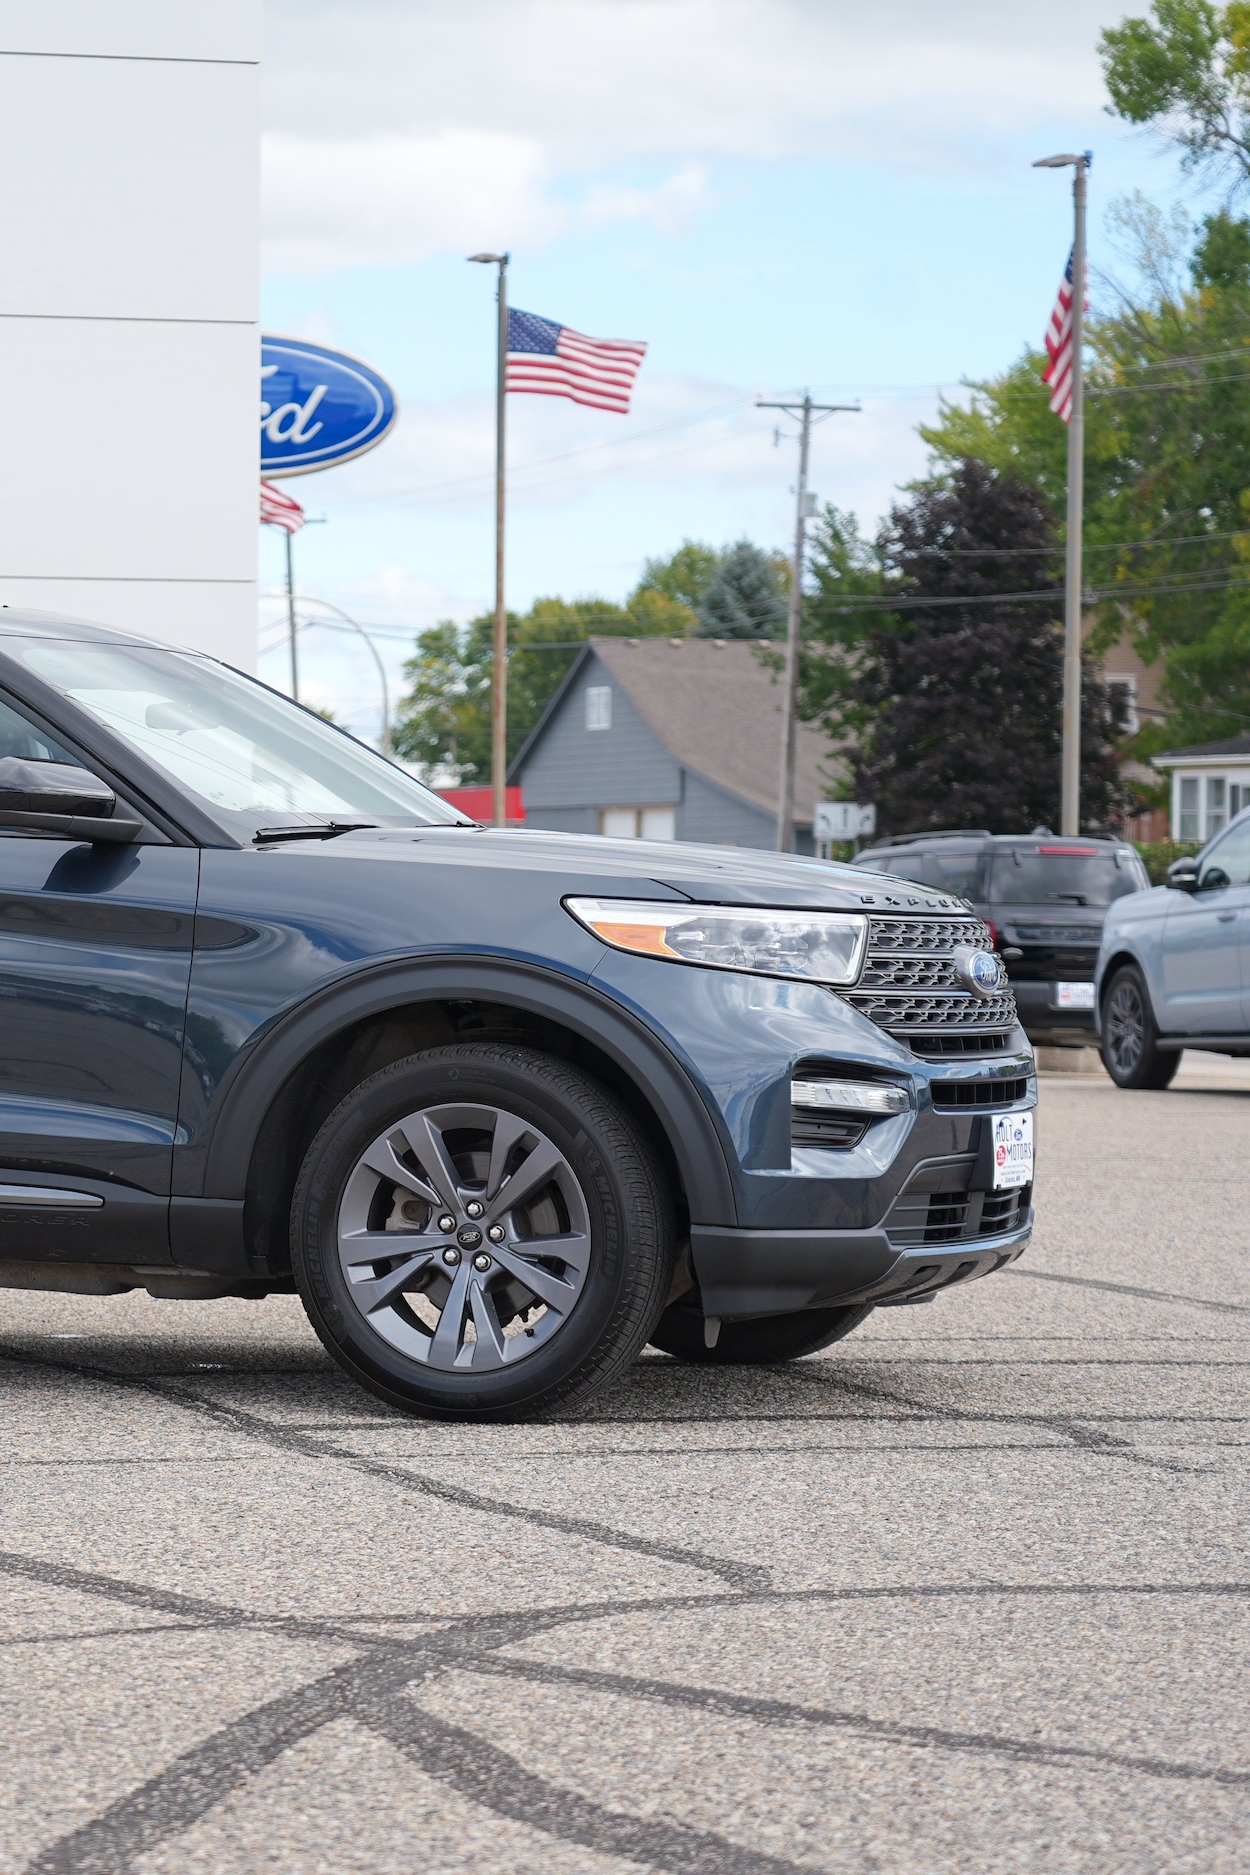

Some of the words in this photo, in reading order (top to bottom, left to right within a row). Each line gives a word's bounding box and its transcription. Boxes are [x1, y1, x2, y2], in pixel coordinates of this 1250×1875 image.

[996, 1124, 1013, 1142] HOLT
[1006, 1143, 1032, 1161] MOTORS
[307, 1198, 331, 1299] MICHELIN
[593, 1176, 618, 1276] MICHELIN
